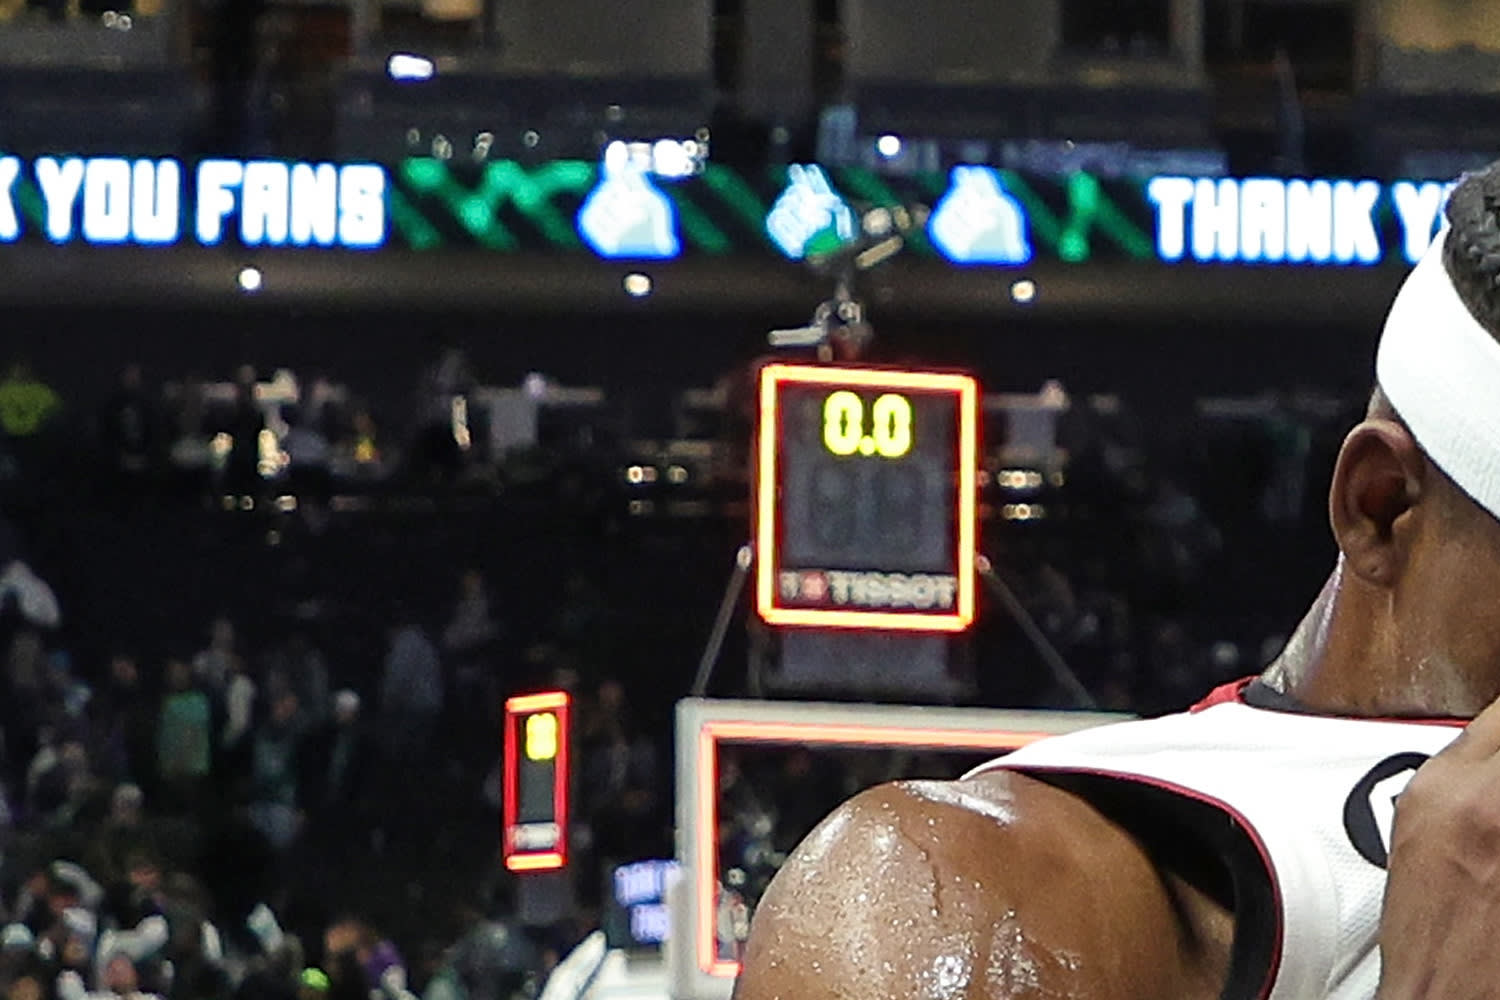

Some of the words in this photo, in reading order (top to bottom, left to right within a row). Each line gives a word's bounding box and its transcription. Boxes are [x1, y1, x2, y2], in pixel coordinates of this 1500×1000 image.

[35, 157, 180, 242] YOU
[196, 160, 386, 245] FANS
[1148, 176, 1380, 262] THANK
[1393, 179, 1449, 264] Y
[823, 391, 912, 457] 0.0
